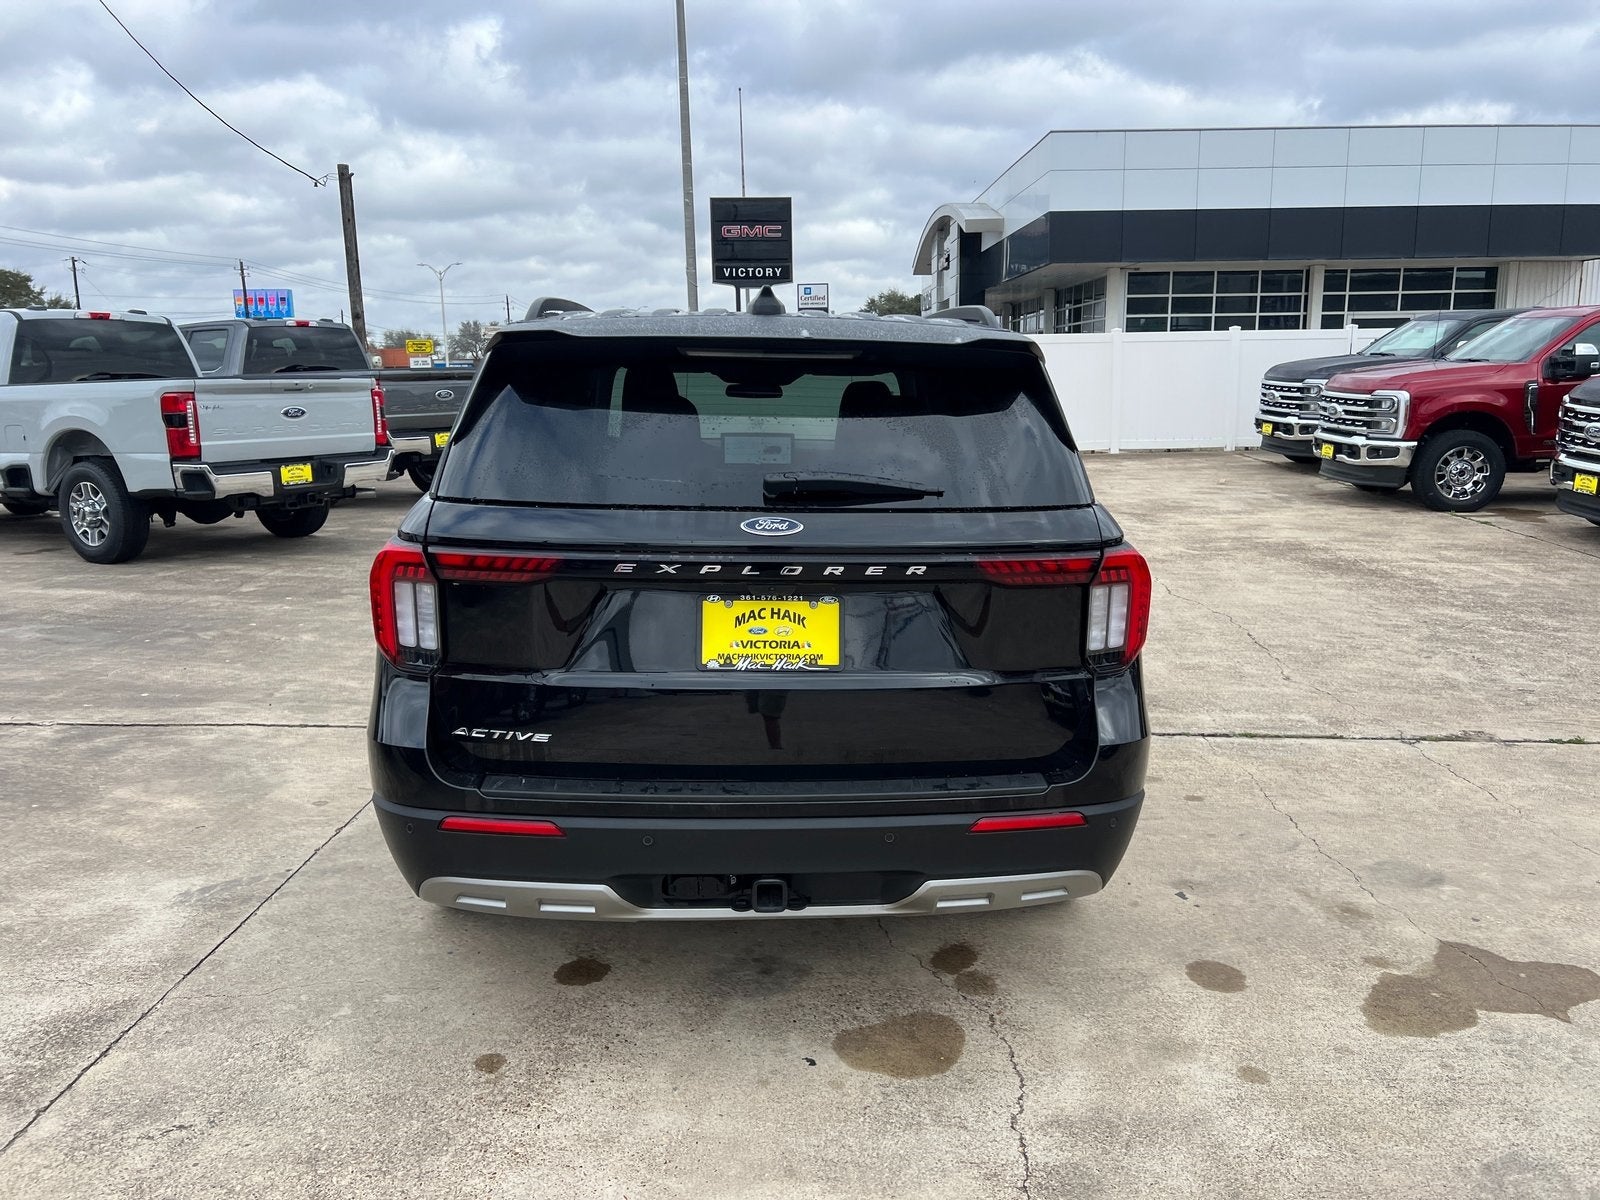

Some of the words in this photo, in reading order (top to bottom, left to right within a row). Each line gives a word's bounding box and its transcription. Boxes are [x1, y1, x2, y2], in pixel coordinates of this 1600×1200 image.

[721, 225, 782, 238] GMC
[723, 267, 782, 277] VICTORY
[755, 519, 788, 531] Ford
[613, 563, 927, 576] EXPLORER
[734, 607, 767, 629] MAC
[770, 607, 807, 629] HAIK
[740, 640, 801, 650] VICTORIA
[717, 653, 824, 661] MACHAIKVICTORIACOM
[735, 657, 770, 671] Mac
[771, 657, 809, 671] Haik
[451, 727, 552, 742] ACTIVE
